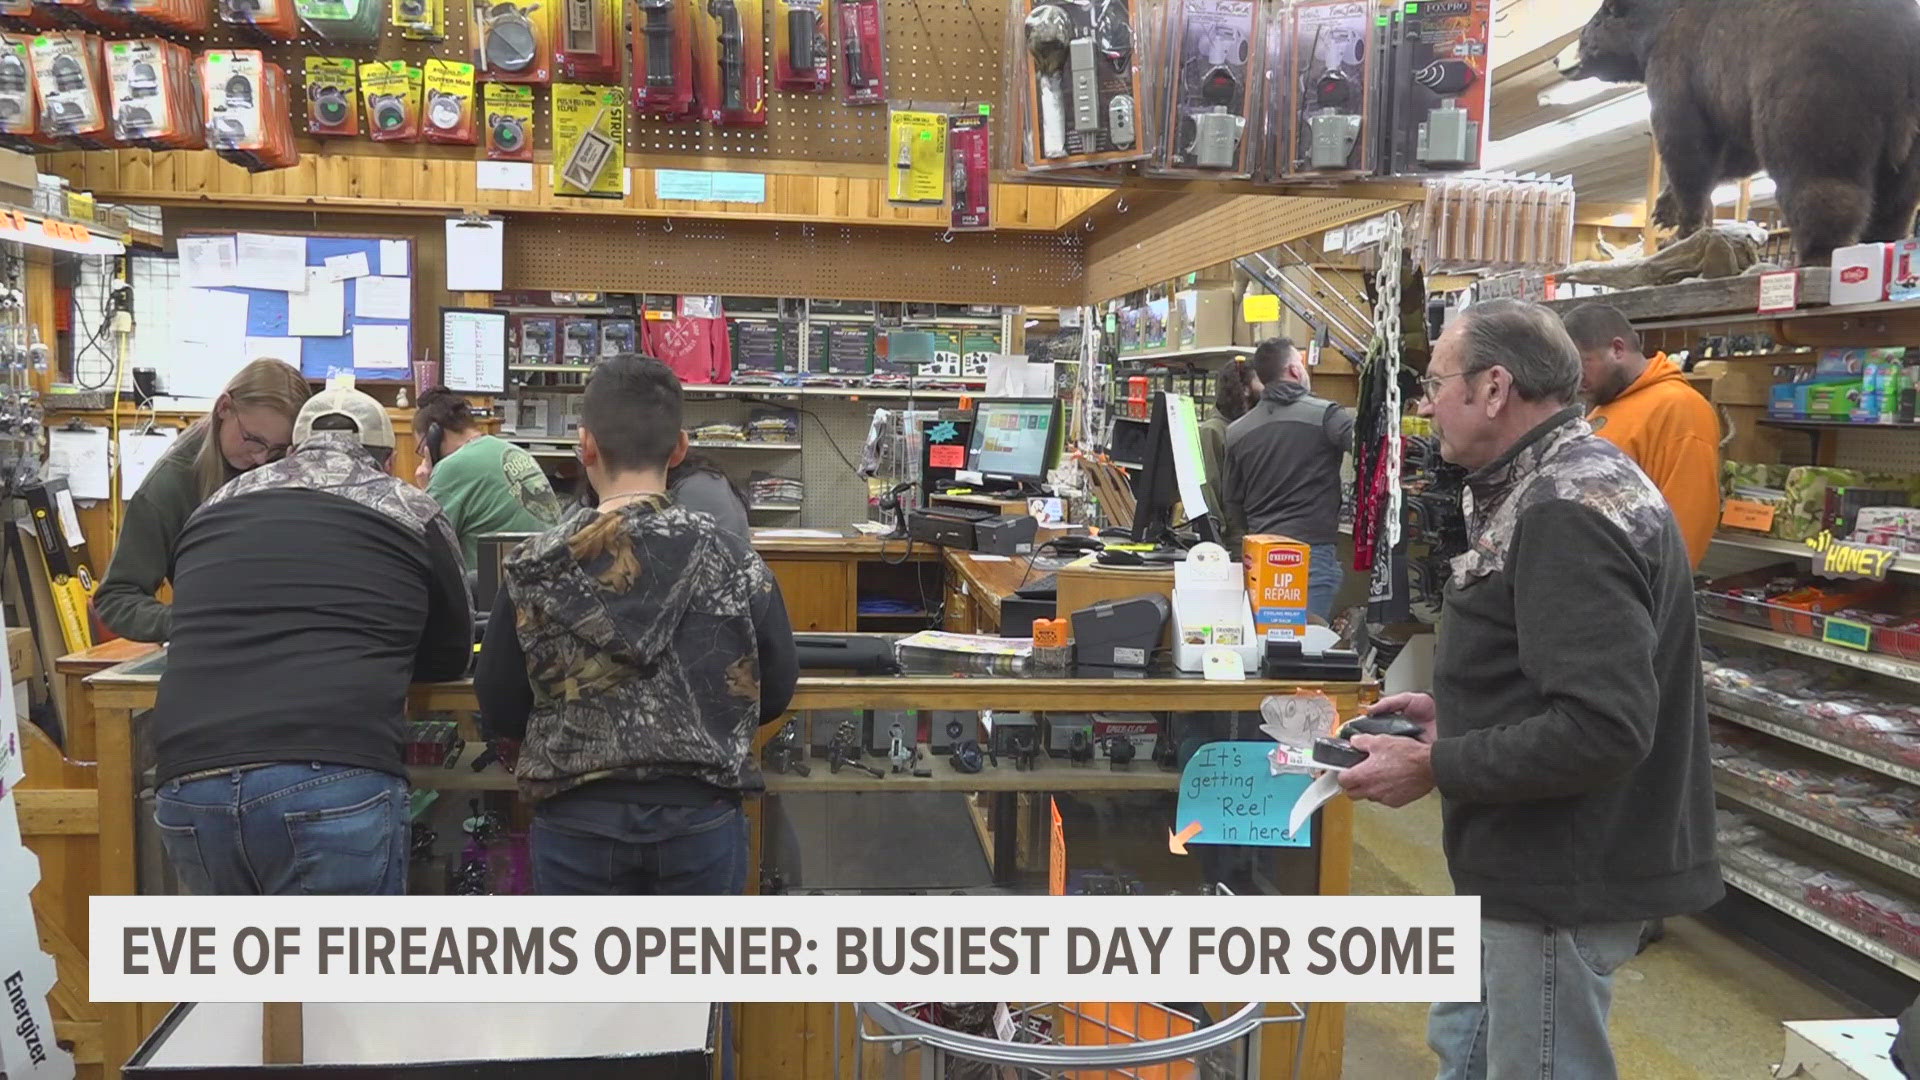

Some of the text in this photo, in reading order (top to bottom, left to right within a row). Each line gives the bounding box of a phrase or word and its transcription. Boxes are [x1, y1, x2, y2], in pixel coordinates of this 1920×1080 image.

[1426, 3, 1467, 12] FOXPRO
[1823, 544, 1893, 577] HONEY
[1274, 573, 1293, 587] LIP
[1264, 587, 1301, 601] REPAIR
[1198, 747, 1242, 767] It's
[1187, 774, 1255, 799] getting
[1217, 794, 1273, 816] "Reel"
[1222, 821, 1297, 843] in here.
[4, 969, 47, 1066] Energizer
